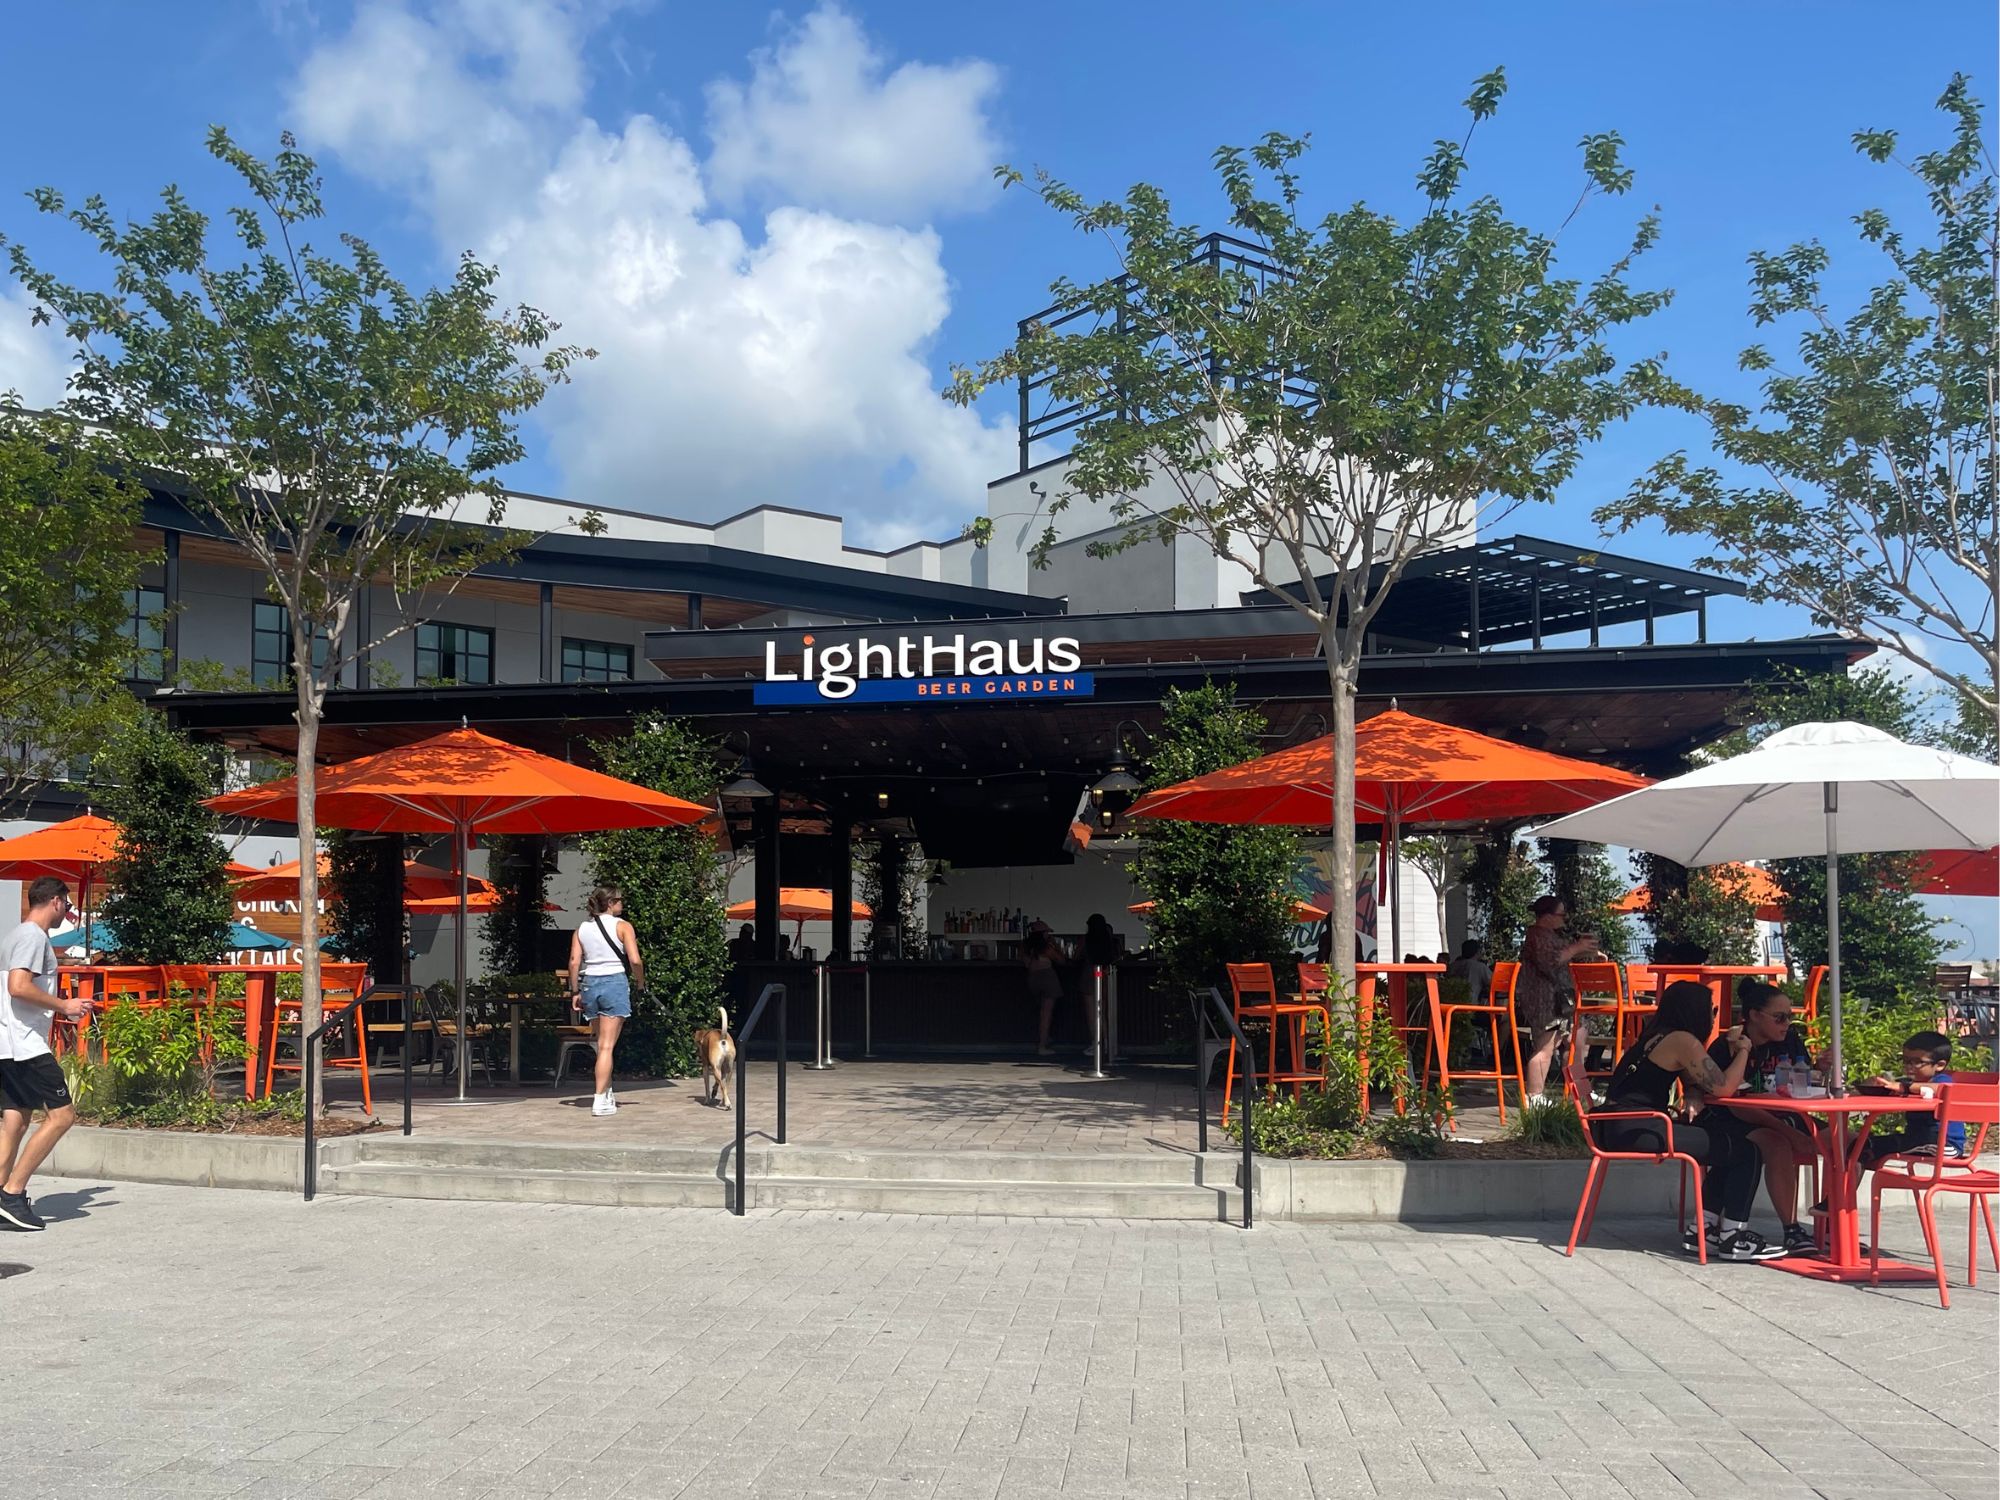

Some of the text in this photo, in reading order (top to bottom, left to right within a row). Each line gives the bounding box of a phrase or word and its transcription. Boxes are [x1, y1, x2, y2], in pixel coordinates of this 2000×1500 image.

[765, 634, 1081, 699] LightHaus
[918, 679, 1075, 695] BEER GARDEN
[237, 899, 325, 914] CHICKN
